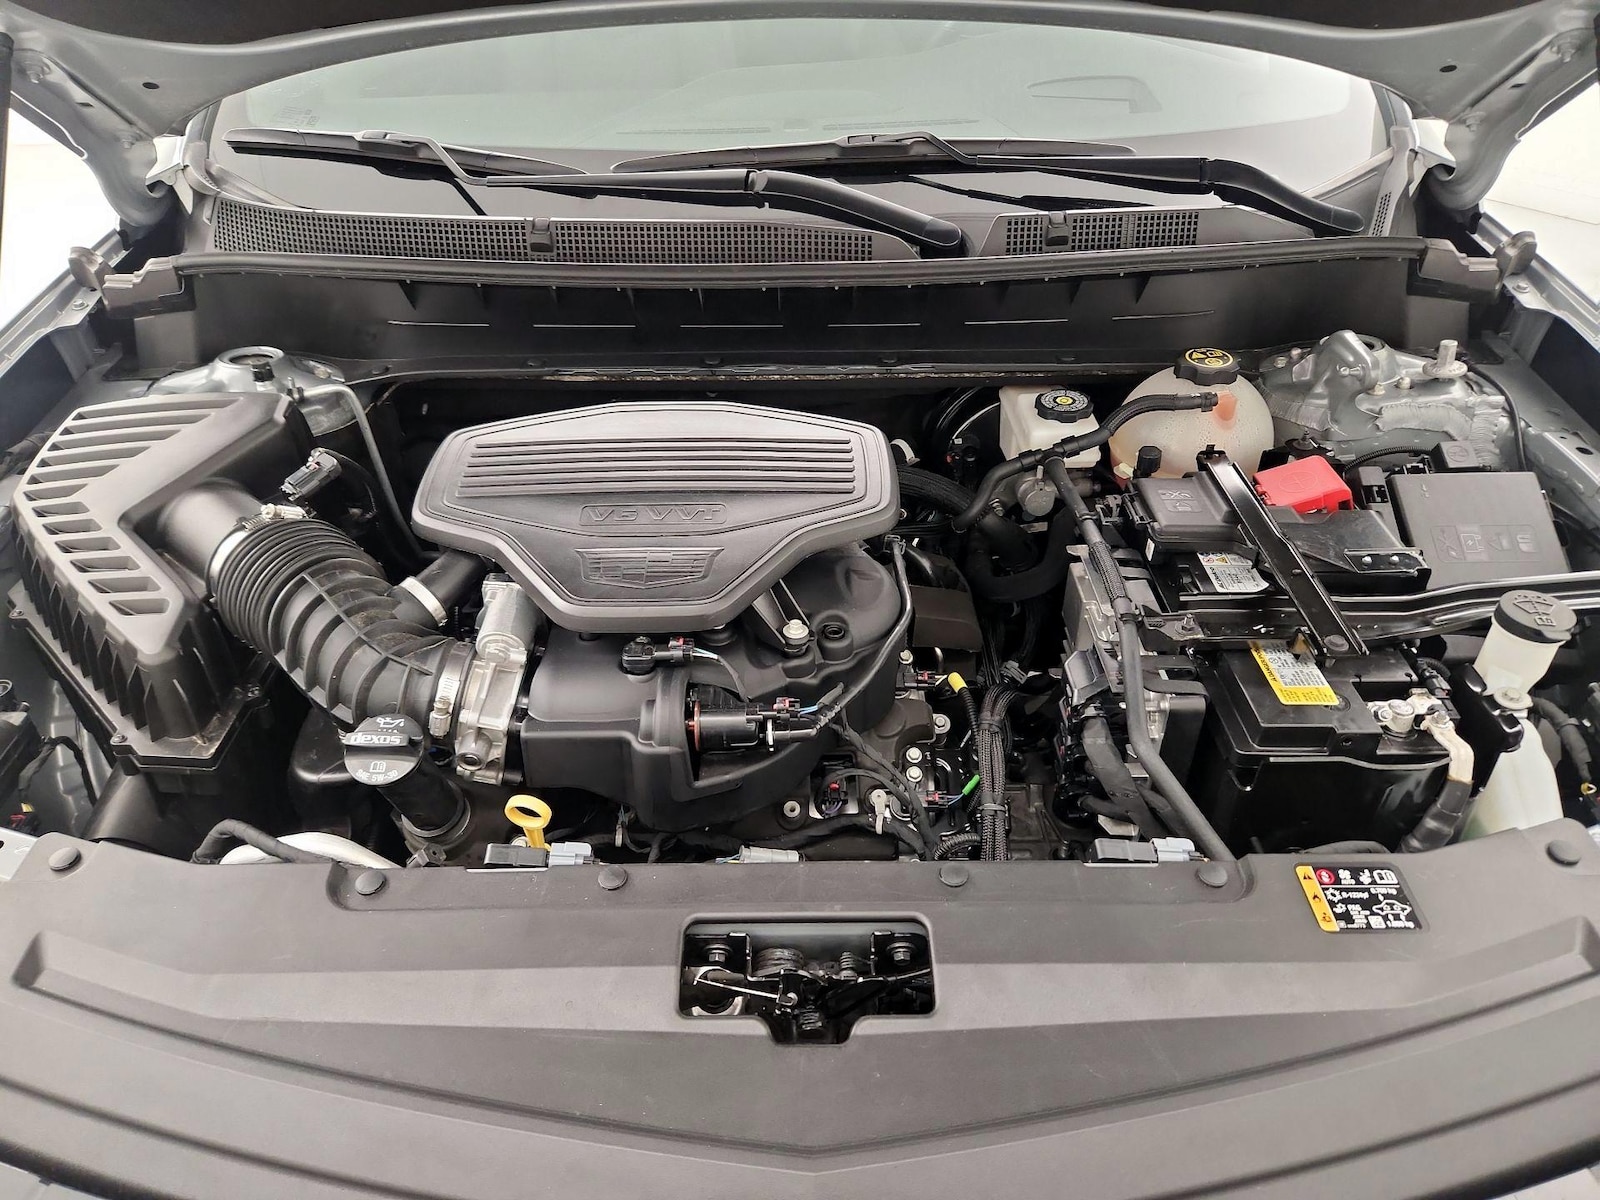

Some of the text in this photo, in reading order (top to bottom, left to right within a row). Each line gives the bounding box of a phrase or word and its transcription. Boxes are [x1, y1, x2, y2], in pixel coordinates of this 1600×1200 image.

[587, 506, 721, 521] V6 VVT
[350, 732, 403, 745] dexos
[356, 768, 398, 781] SAE 5W-30
